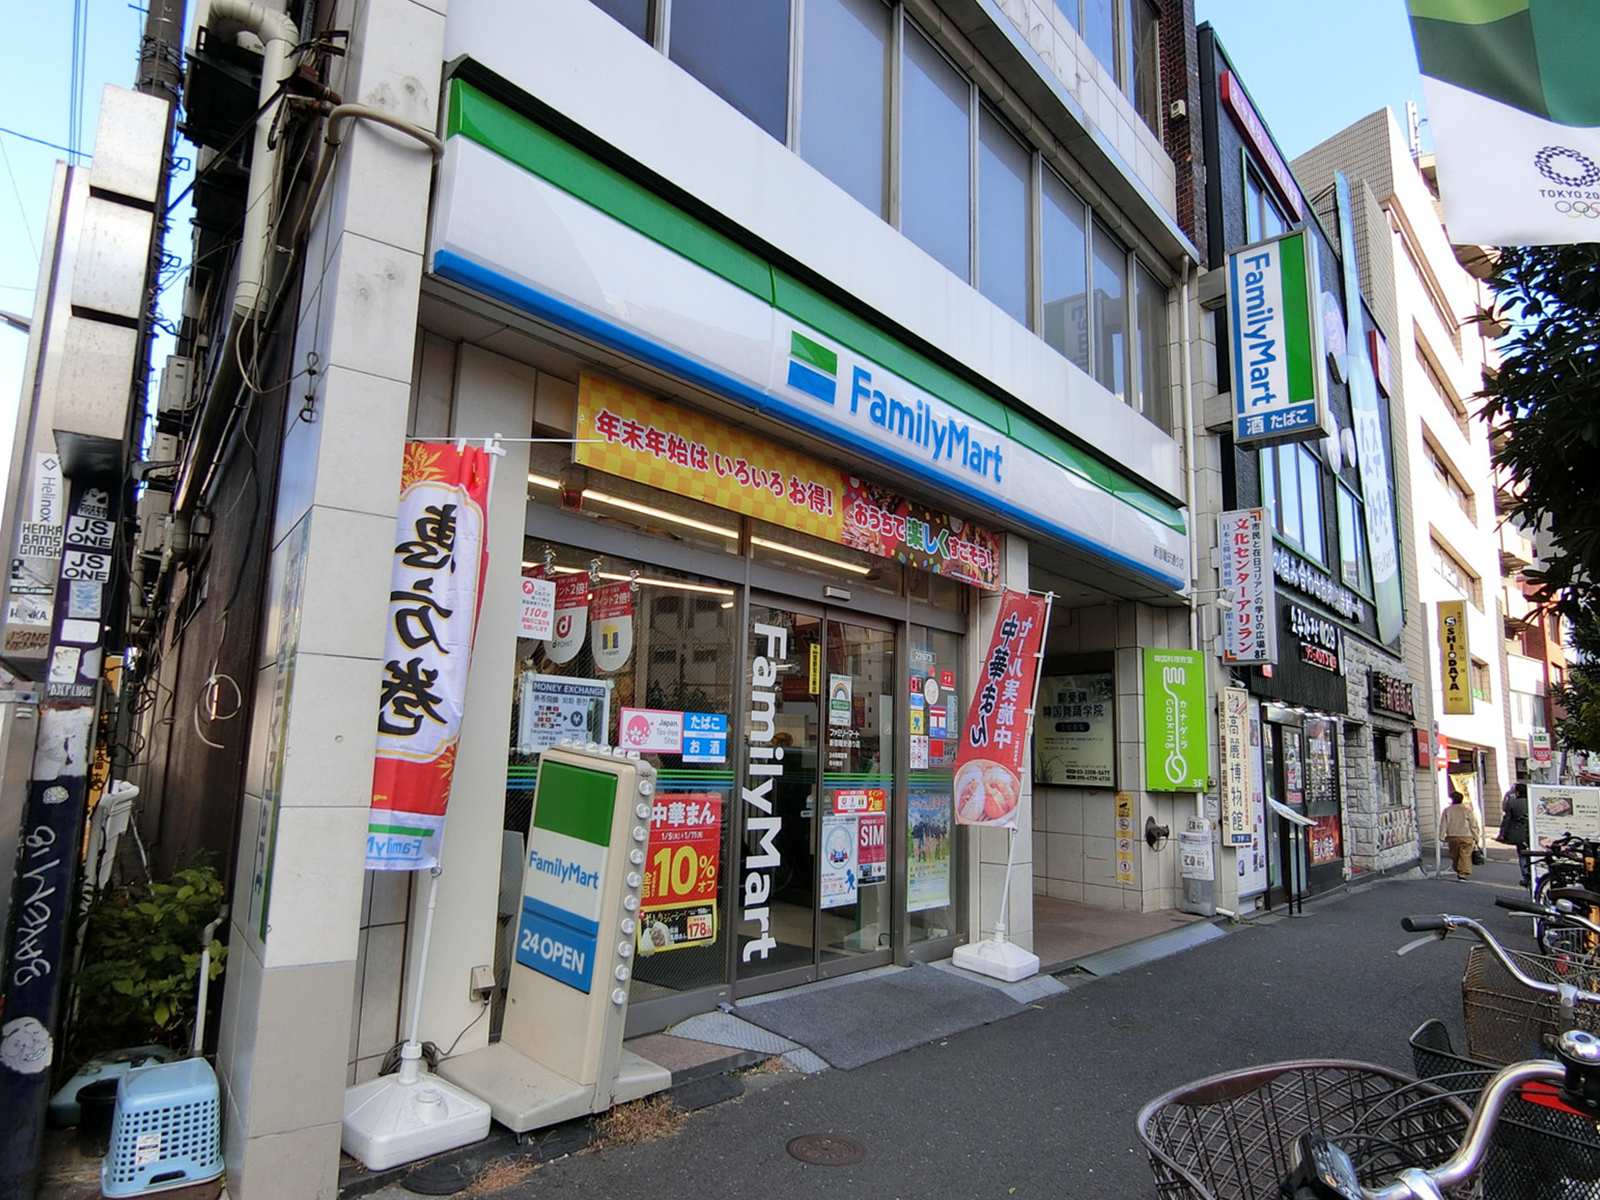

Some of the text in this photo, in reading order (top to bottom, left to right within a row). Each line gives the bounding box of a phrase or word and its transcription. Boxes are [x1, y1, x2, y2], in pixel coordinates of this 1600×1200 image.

[1539, 189, 1600, 200] TOKYO 20
[1243, 252, 1277, 407] FamilyMart
[849, 365, 1003, 483] FamilyMart
[1246, 409, 1308, 435] 酒 たばこ
[595, 408, 834, 517] 年末年始は いろいろ お得!
[40, 476, 56, 523] Helinox
[22, 523, 62, 537] HENKA
[75, 518, 108, 536] JS
[22, 534, 61, 547] BAMS
[68, 533, 112, 549] ONE
[20, 544, 61, 558] GNASH
[71, 553, 104, 570] JS
[64, 567, 108, 582] ONE
[1234, 518, 1254, 653] 文化センターアリラン
[1252, 523, 1266, 648] 市民と在日コリアンの学びの広場
[1254, 650, 1266, 659] 8F
[1446, 627, 1460, 690] SHIODAYA
[534, 682, 605, 696] MONEY EXCHANGE
[690, 714, 720, 730] たばこ
[657, 728, 679, 736] Tax-free
[829, 728, 861, 738] ファミリーマート
[664, 737, 678, 745] Shop
[1229, 714, 1243, 832] 高麗博物館
[1193, 779, 1203, 788] 3F
[742, 622, 788, 963] FamilyMart
[651, 802, 715, 828] 中華まん
[860, 825, 884, 846] SIM
[528, 850, 599, 890] FamilyMart
[698, 880, 716, 894] オフ
